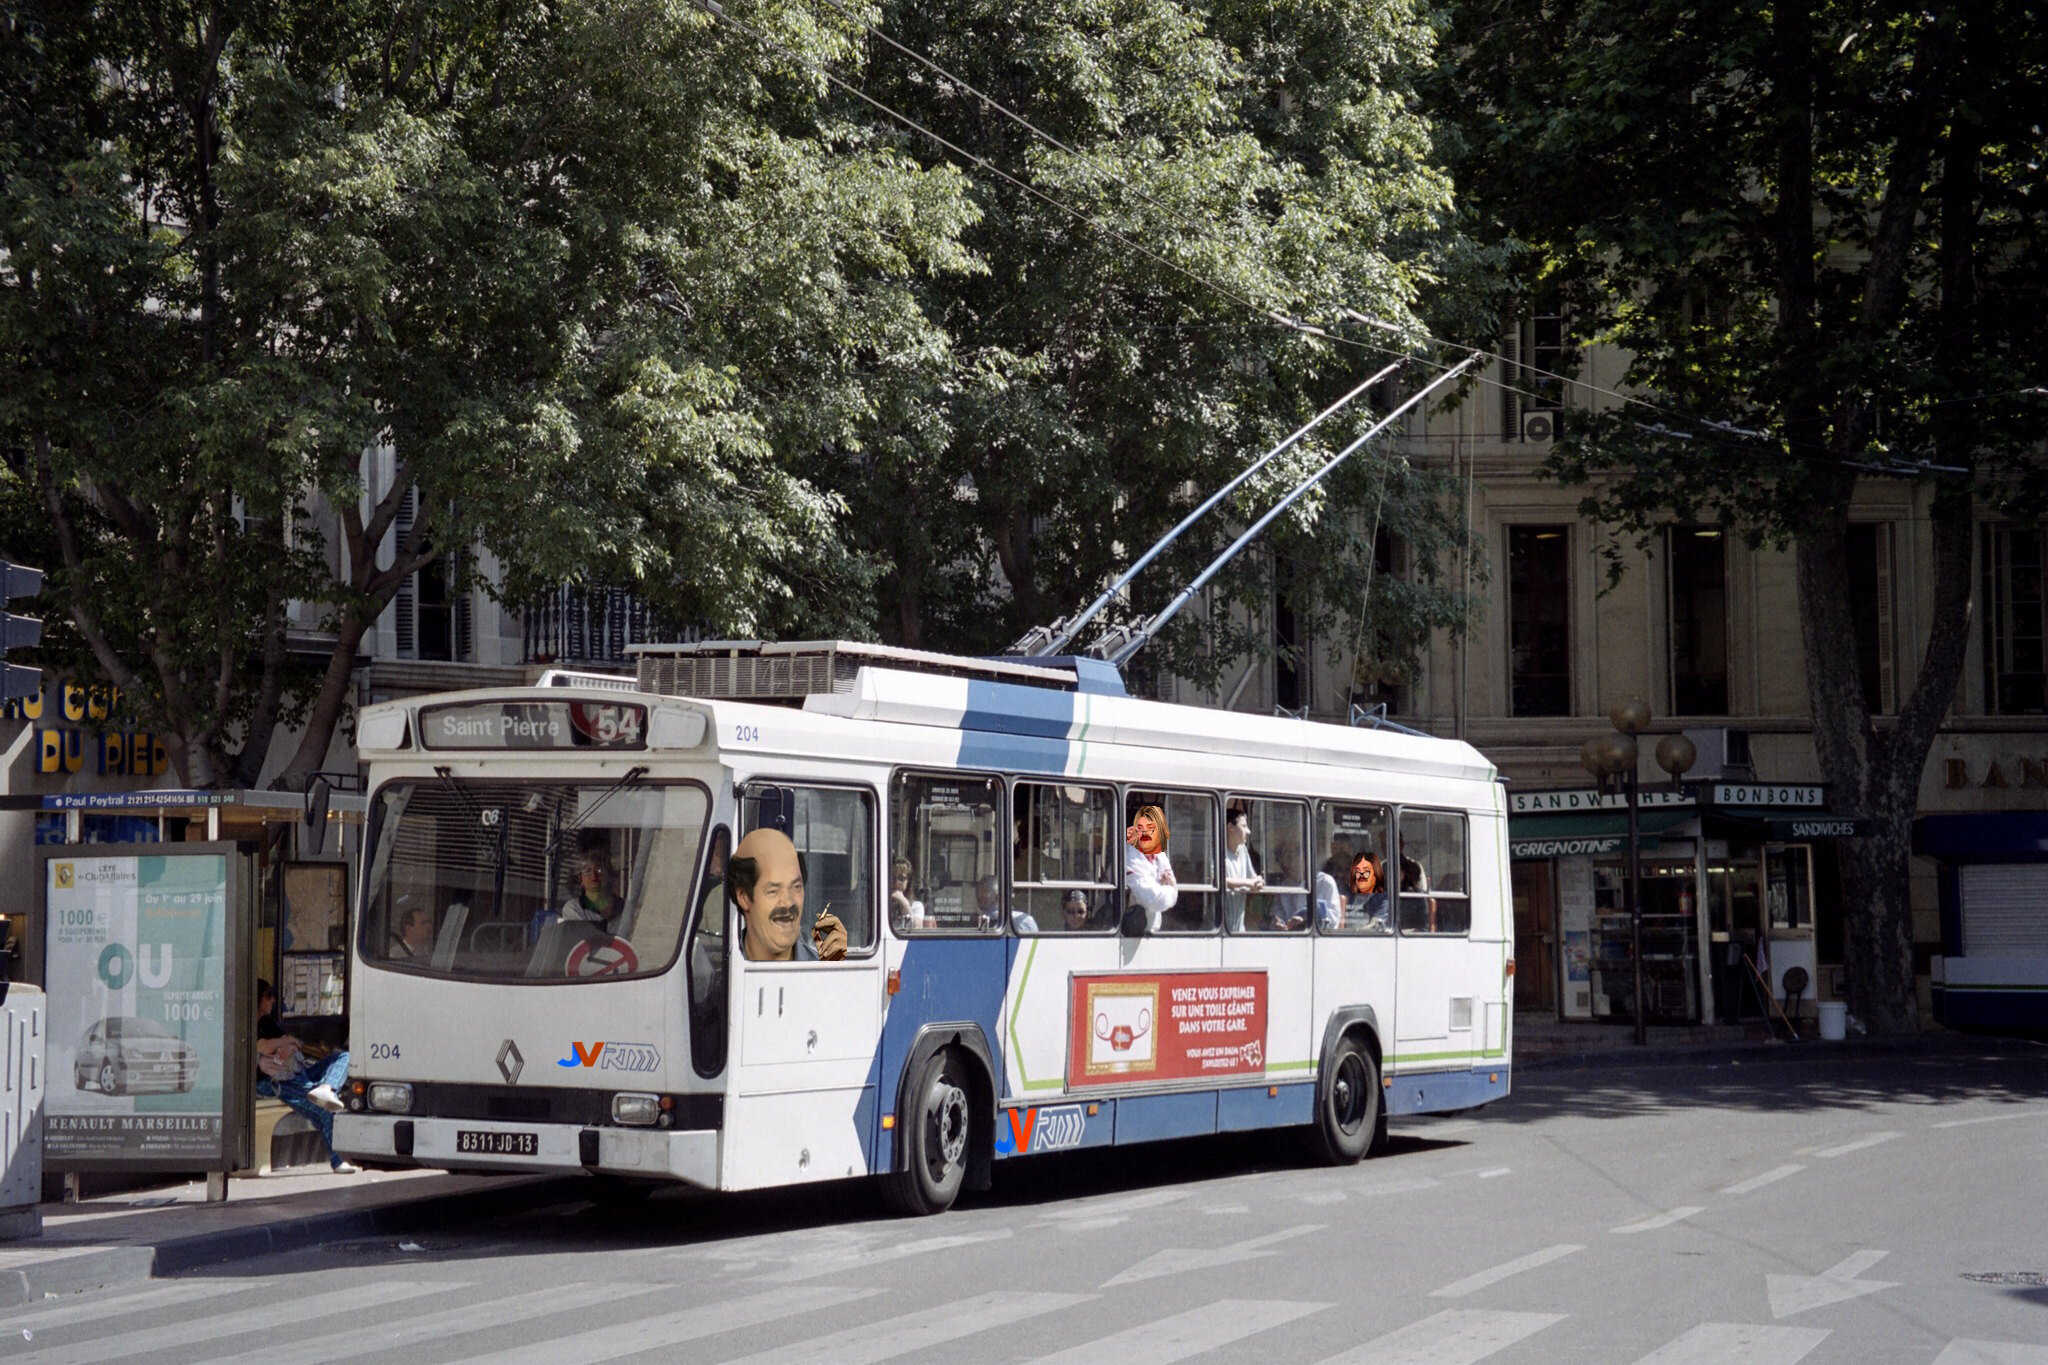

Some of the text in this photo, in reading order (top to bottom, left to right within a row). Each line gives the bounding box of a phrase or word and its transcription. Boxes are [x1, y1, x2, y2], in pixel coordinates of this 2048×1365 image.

[444, 715, 561, 738] Saint Pierre
[598, 708, 642, 742] 54
[736, 725, 759, 742] 204
[40, 729, 169, 775] DU PIED
[65, 797, 87, 807] Paul
[90, 795, 125, 807] Peytral
[1517, 791, 1687, 810] SANDWIHES
[1723, 788, 1816, 803] BONBONS
[145, 894, 158, 904] Du
[174, 895, 187, 904] au
[190, 893, 203, 903] 29
[204, 893, 222, 905] juin
[59, 910, 94, 924] 1000
[98, 943, 173, 990] OU
[1172, 986, 1255, 1001] VENEZ VOUS EXPRIMER
[164, 1003, 200, 1021] 1000
[1172, 1001, 1255, 1018] SUR UNE TOILE GÉANTE
[1179, 1021, 1201, 1034] DANS
[1202, 1020, 1226, 1033] VOTRE
[370, 1044, 401, 1060] 204
[50, 1118, 208, 1130] RENAULT MARSEILLE
[462, 1132, 494, 1151] 8311
[517, 1136, 533, 1152] 13
